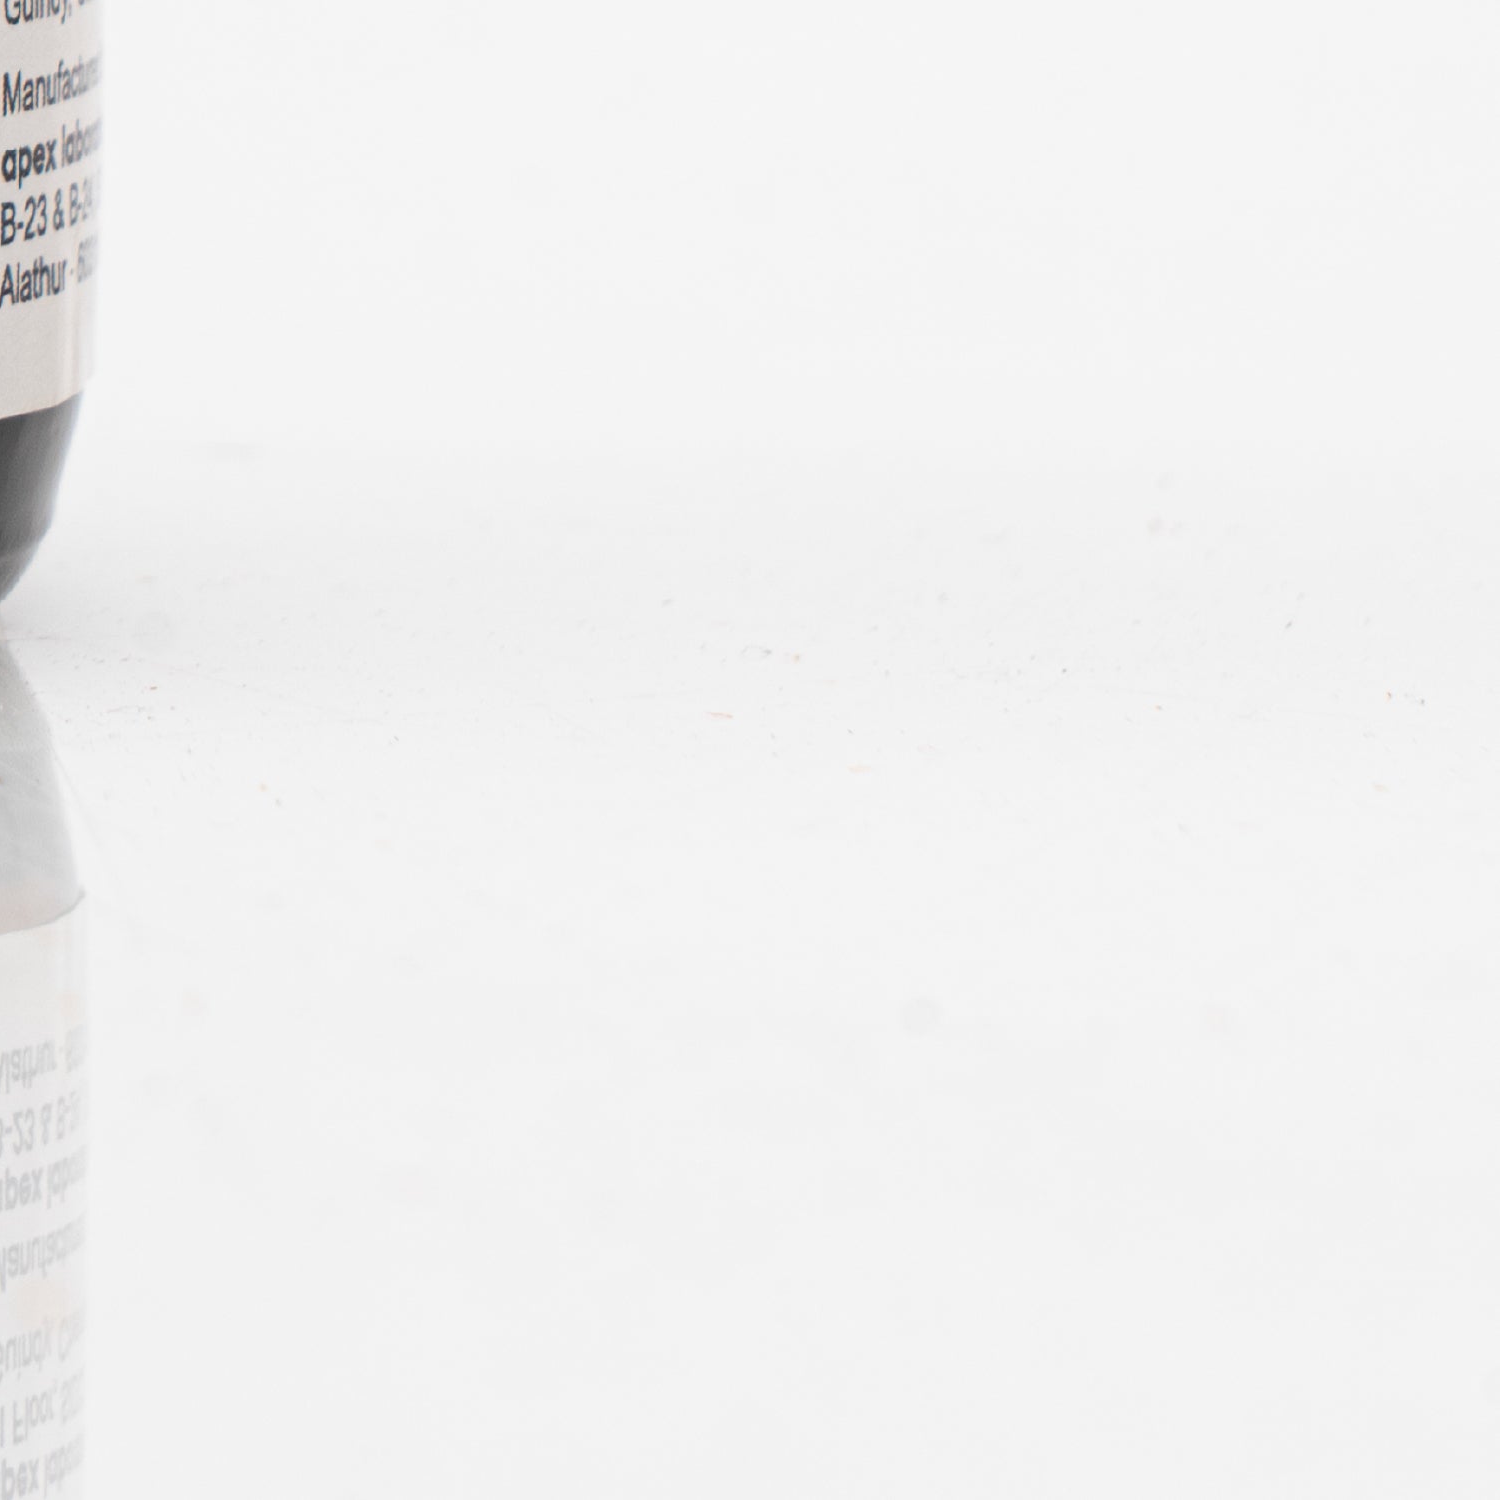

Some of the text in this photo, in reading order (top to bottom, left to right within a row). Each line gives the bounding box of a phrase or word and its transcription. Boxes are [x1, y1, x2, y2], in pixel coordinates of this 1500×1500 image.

[1, 136, 57, 190] apex
[0, 193, 47, 247] B-23
[53, 187, 64, 232] &
